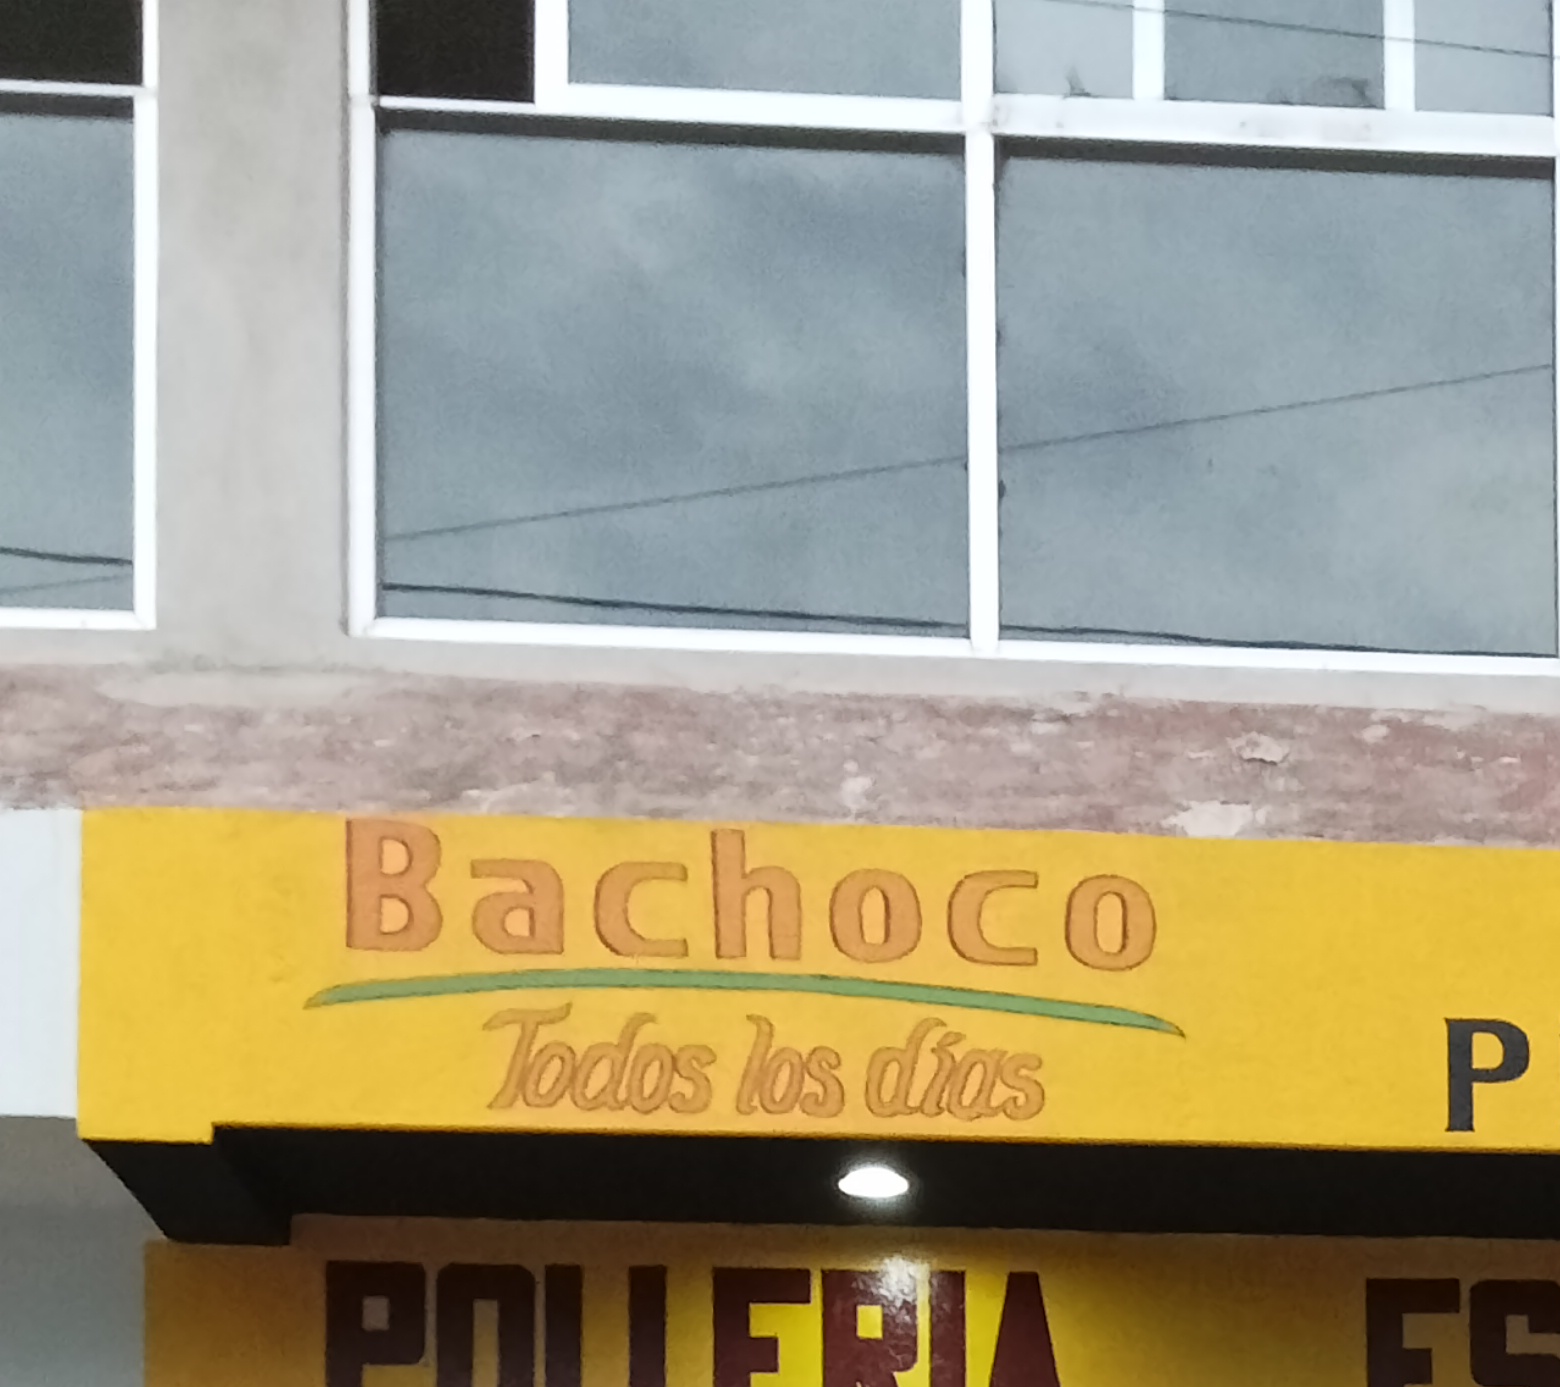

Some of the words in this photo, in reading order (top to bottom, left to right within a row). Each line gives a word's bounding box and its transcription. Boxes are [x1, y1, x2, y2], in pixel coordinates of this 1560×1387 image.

[345, 818, 1158, 971] Bachoco
[483, 1003, 711, 1114] Todos
[735, 1012, 845, 1118] los
[865, 1018, 1045, 1122] días
